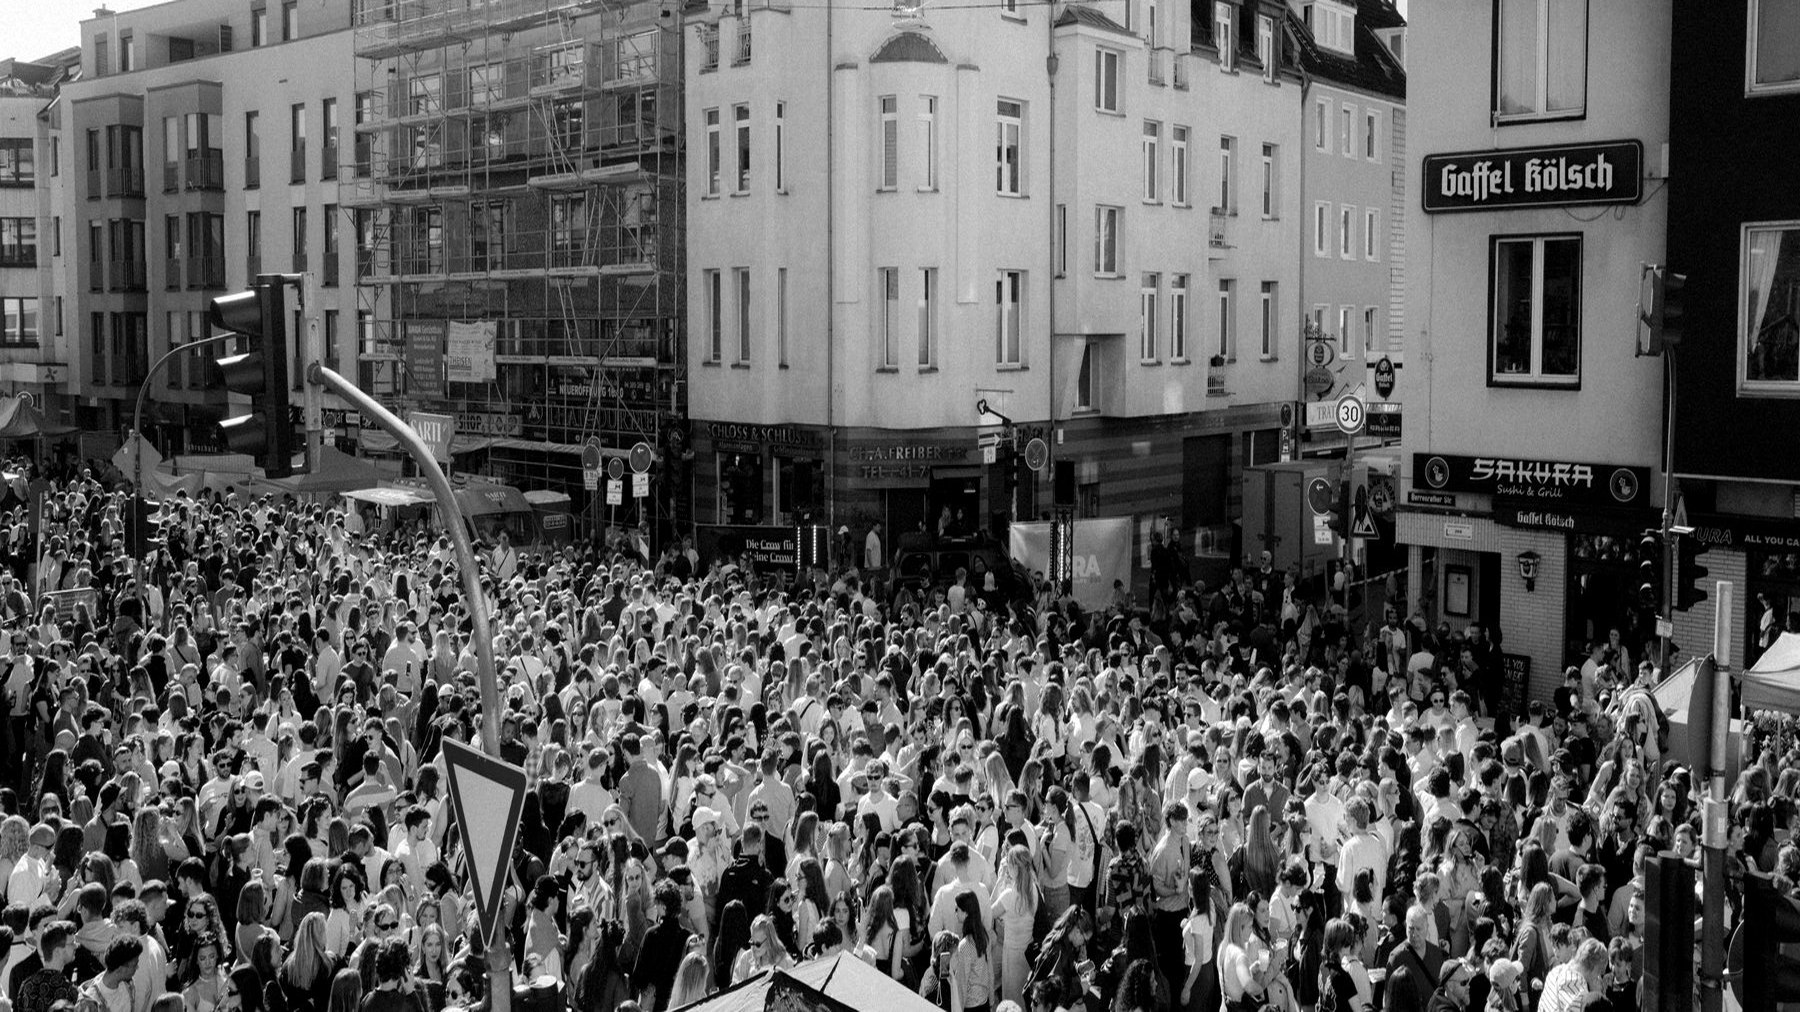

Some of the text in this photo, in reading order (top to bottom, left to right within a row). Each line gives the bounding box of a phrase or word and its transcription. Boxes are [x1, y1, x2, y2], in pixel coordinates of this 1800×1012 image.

[1441, 153, 1613, 202] Gaffel Kölsch
[1341, 405, 1359, 422] 30
[1469, 458, 1594, 488] SAKURA
[1497, 484, 1563, 498] Sushi & Grill
[1517, 511, 1543, 526] Gaffel
[746, 539, 759, 549] Die
[760, 539, 781, 550] Crow
[1690, 527, 1733, 545] URA
[1745, 534, 1762, 543] ALL
[1764, 536, 1784, 545] YOU
